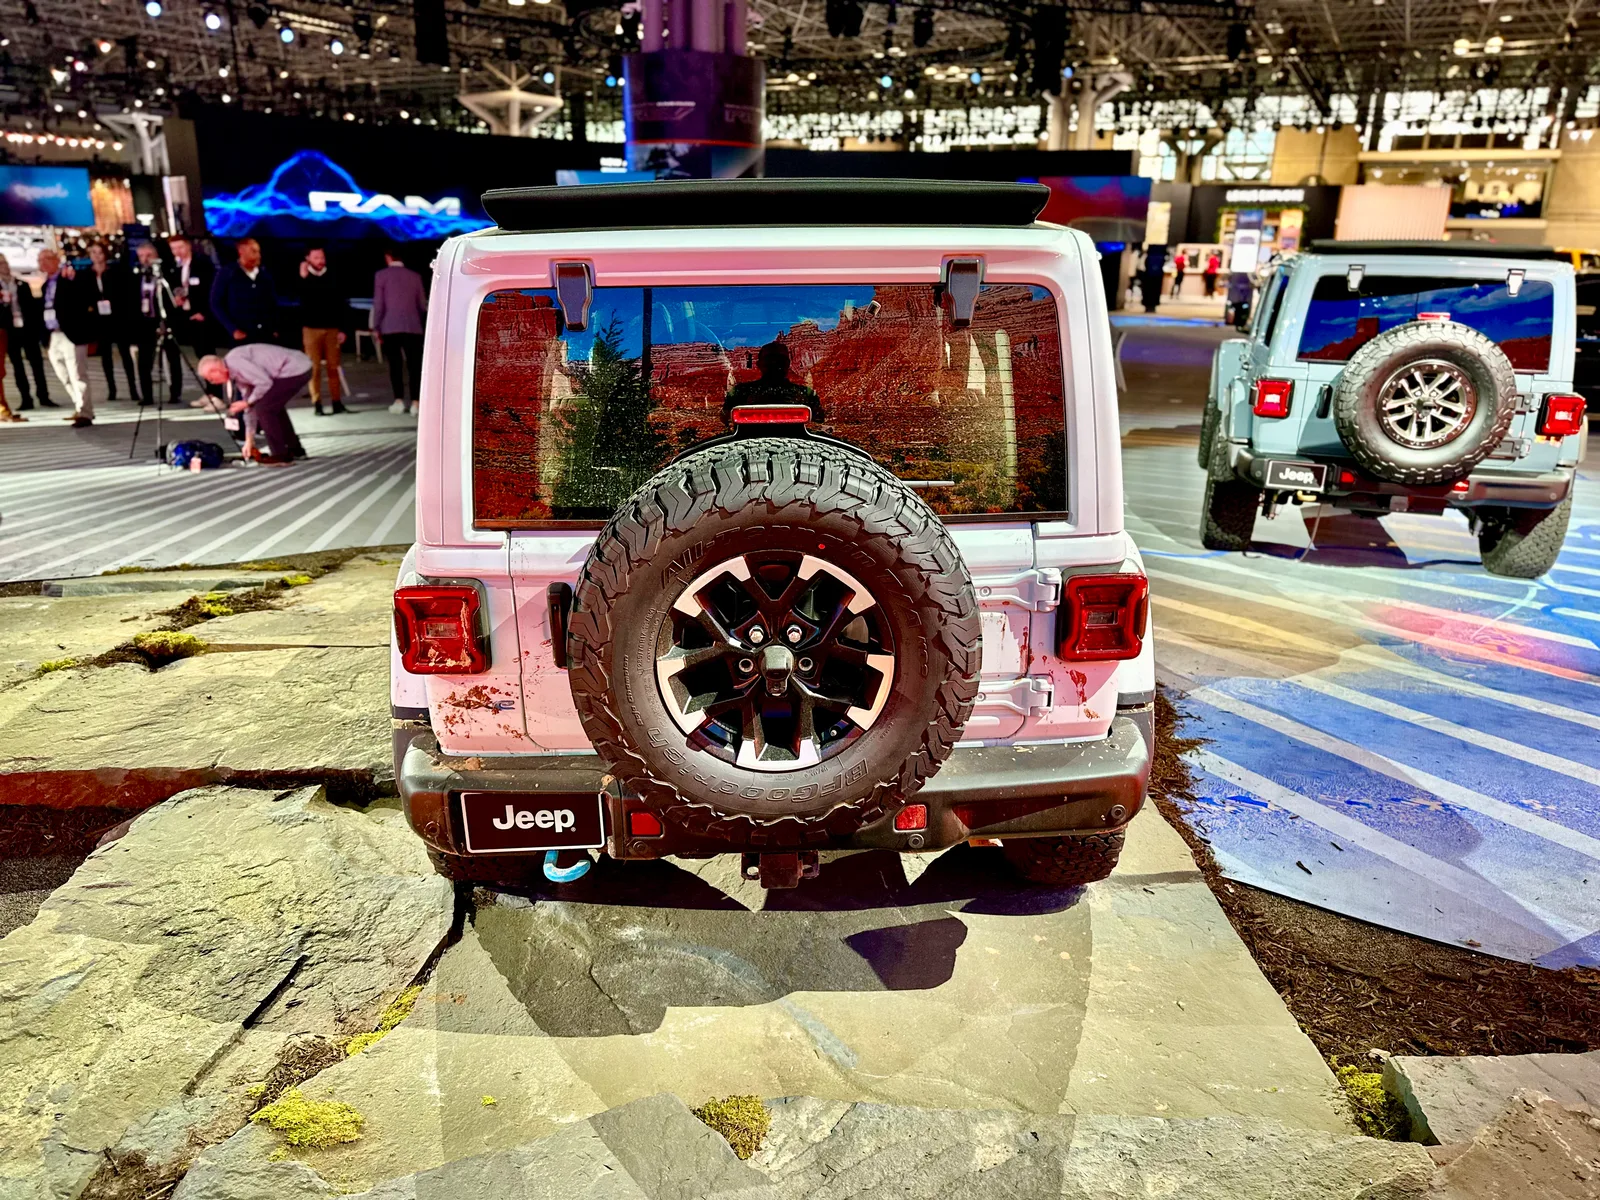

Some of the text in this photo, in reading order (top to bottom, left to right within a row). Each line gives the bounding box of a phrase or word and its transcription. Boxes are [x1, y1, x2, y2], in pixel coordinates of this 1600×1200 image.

[309, 191, 460, 216] RAM
[1279, 467, 1315, 484] Jeep
[647, 727, 868, 803] BFGoodrich
[492, 804, 576, 833] Jeep
